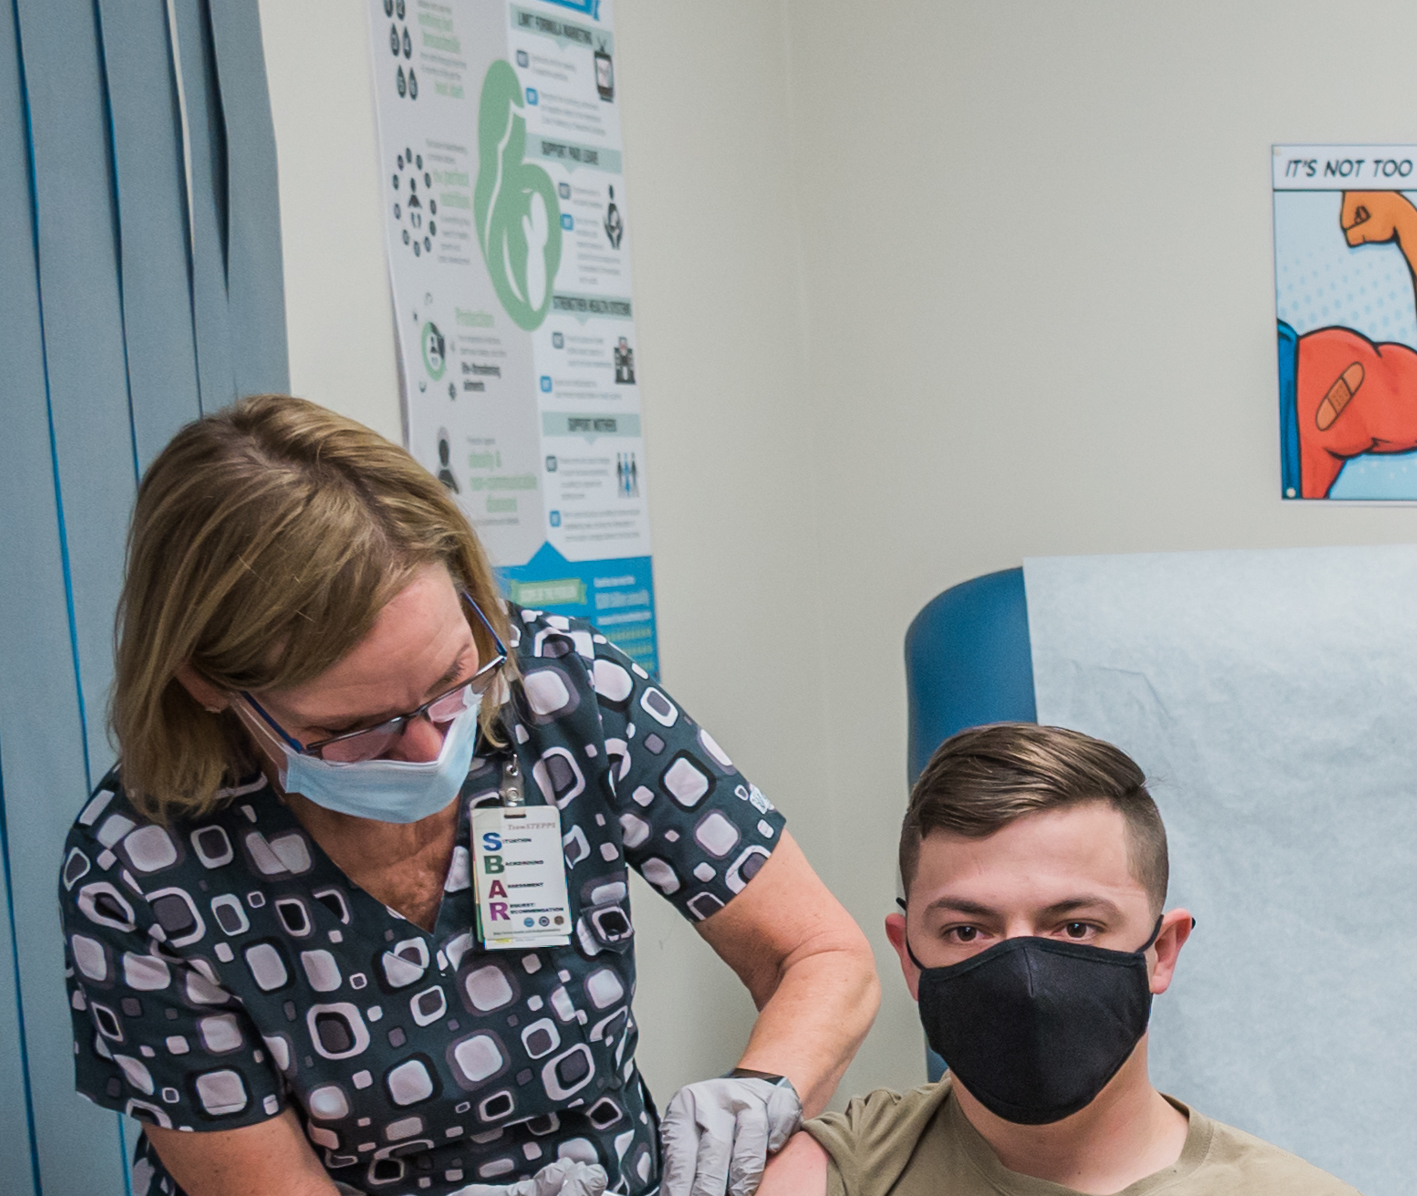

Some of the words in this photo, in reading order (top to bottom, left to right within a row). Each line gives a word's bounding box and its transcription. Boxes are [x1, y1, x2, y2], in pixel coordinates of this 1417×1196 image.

[1285, 159, 1316, 178] IT'S
[1324, 159, 1363, 178] NOT
[1373, 159, 1413, 177] TOO
